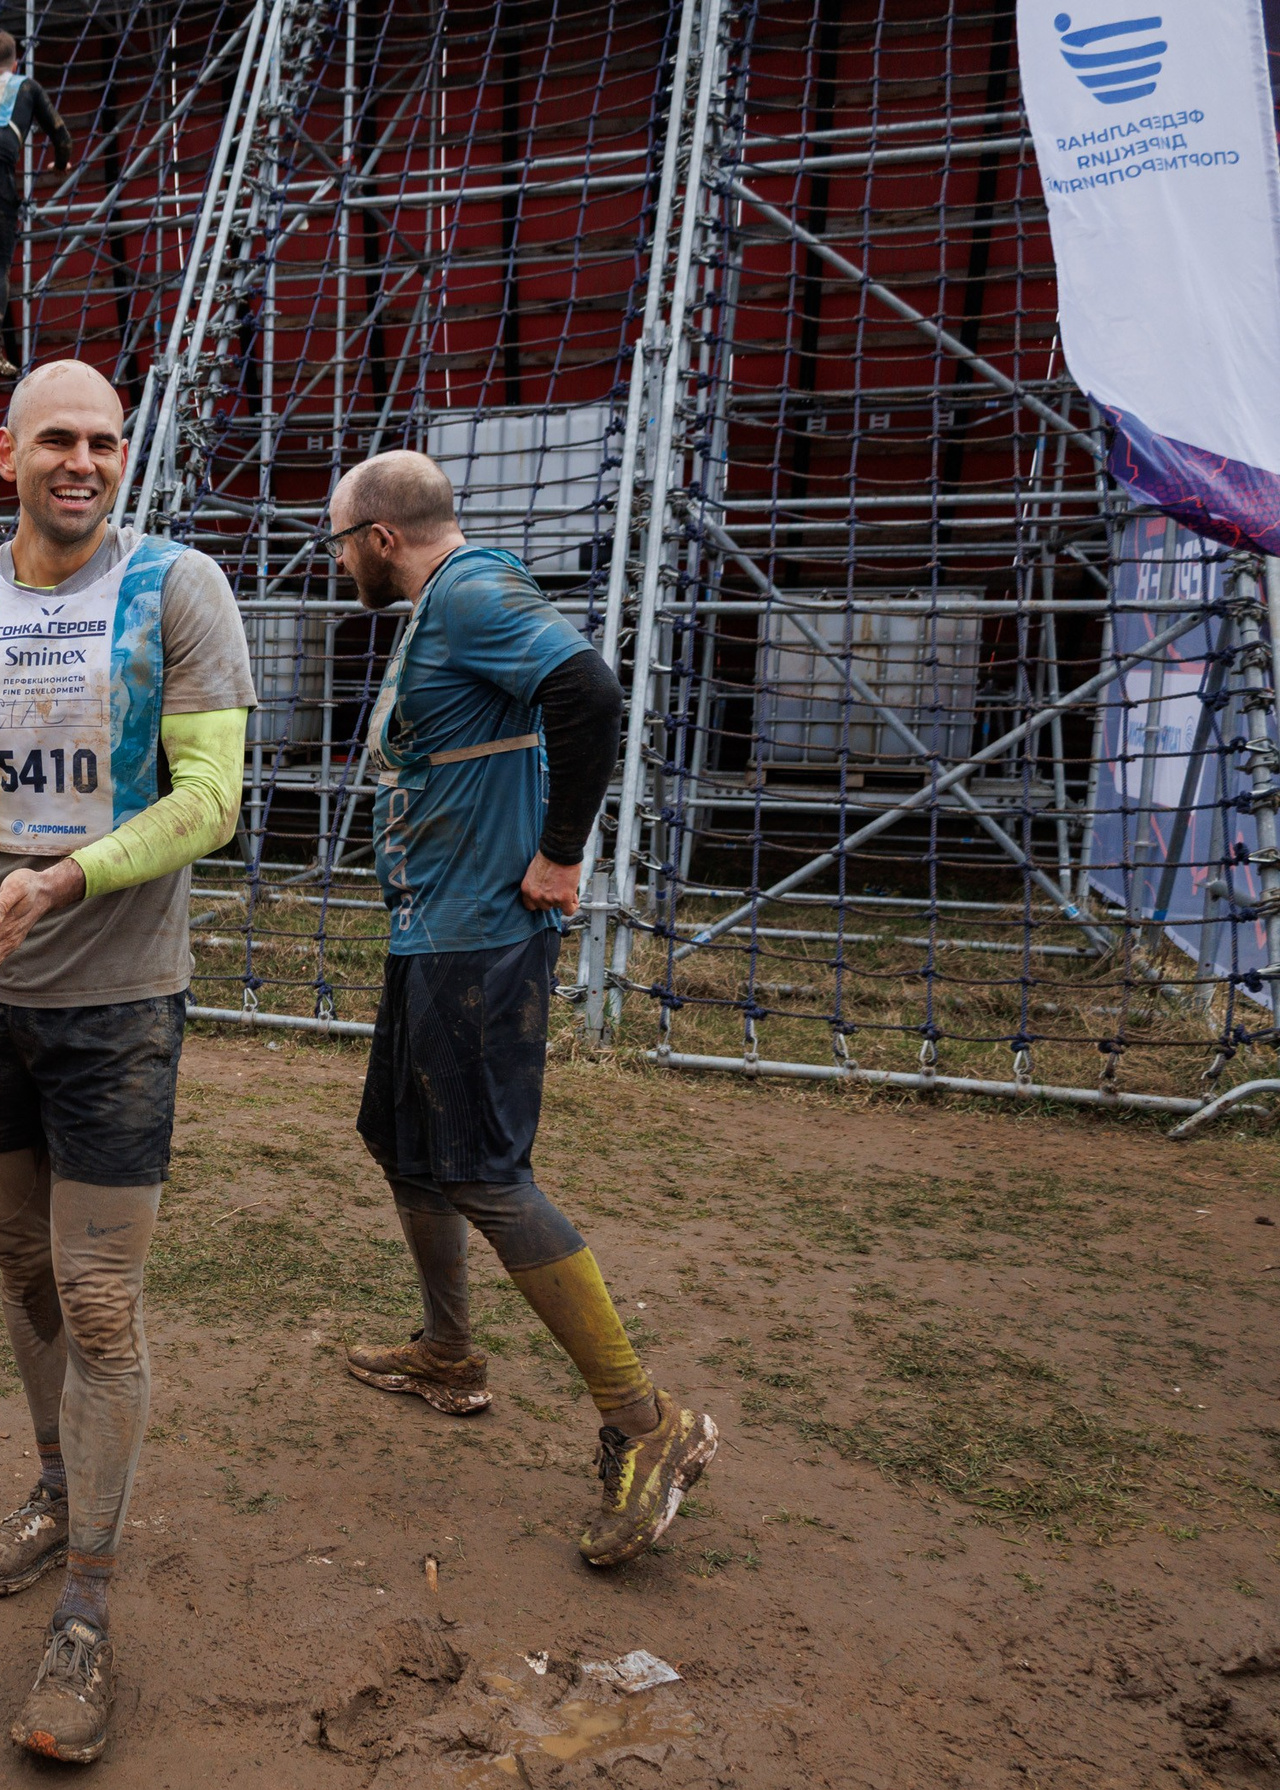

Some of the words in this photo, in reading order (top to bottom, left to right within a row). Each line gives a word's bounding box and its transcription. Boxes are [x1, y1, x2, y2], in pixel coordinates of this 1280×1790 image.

[47, 620, 107, 634] ГЕРОЕВ
[5, 646, 86, 667] Sminex
[3, 675, 86, 685] ПЕРФЕКЦИОНИСТЫ
[3, 687, 21, 695] FINE
[25, 687, 85, 695] DEVELOPMENT
[27, 823, 87, 835] ГАЗПРОМБАНК
